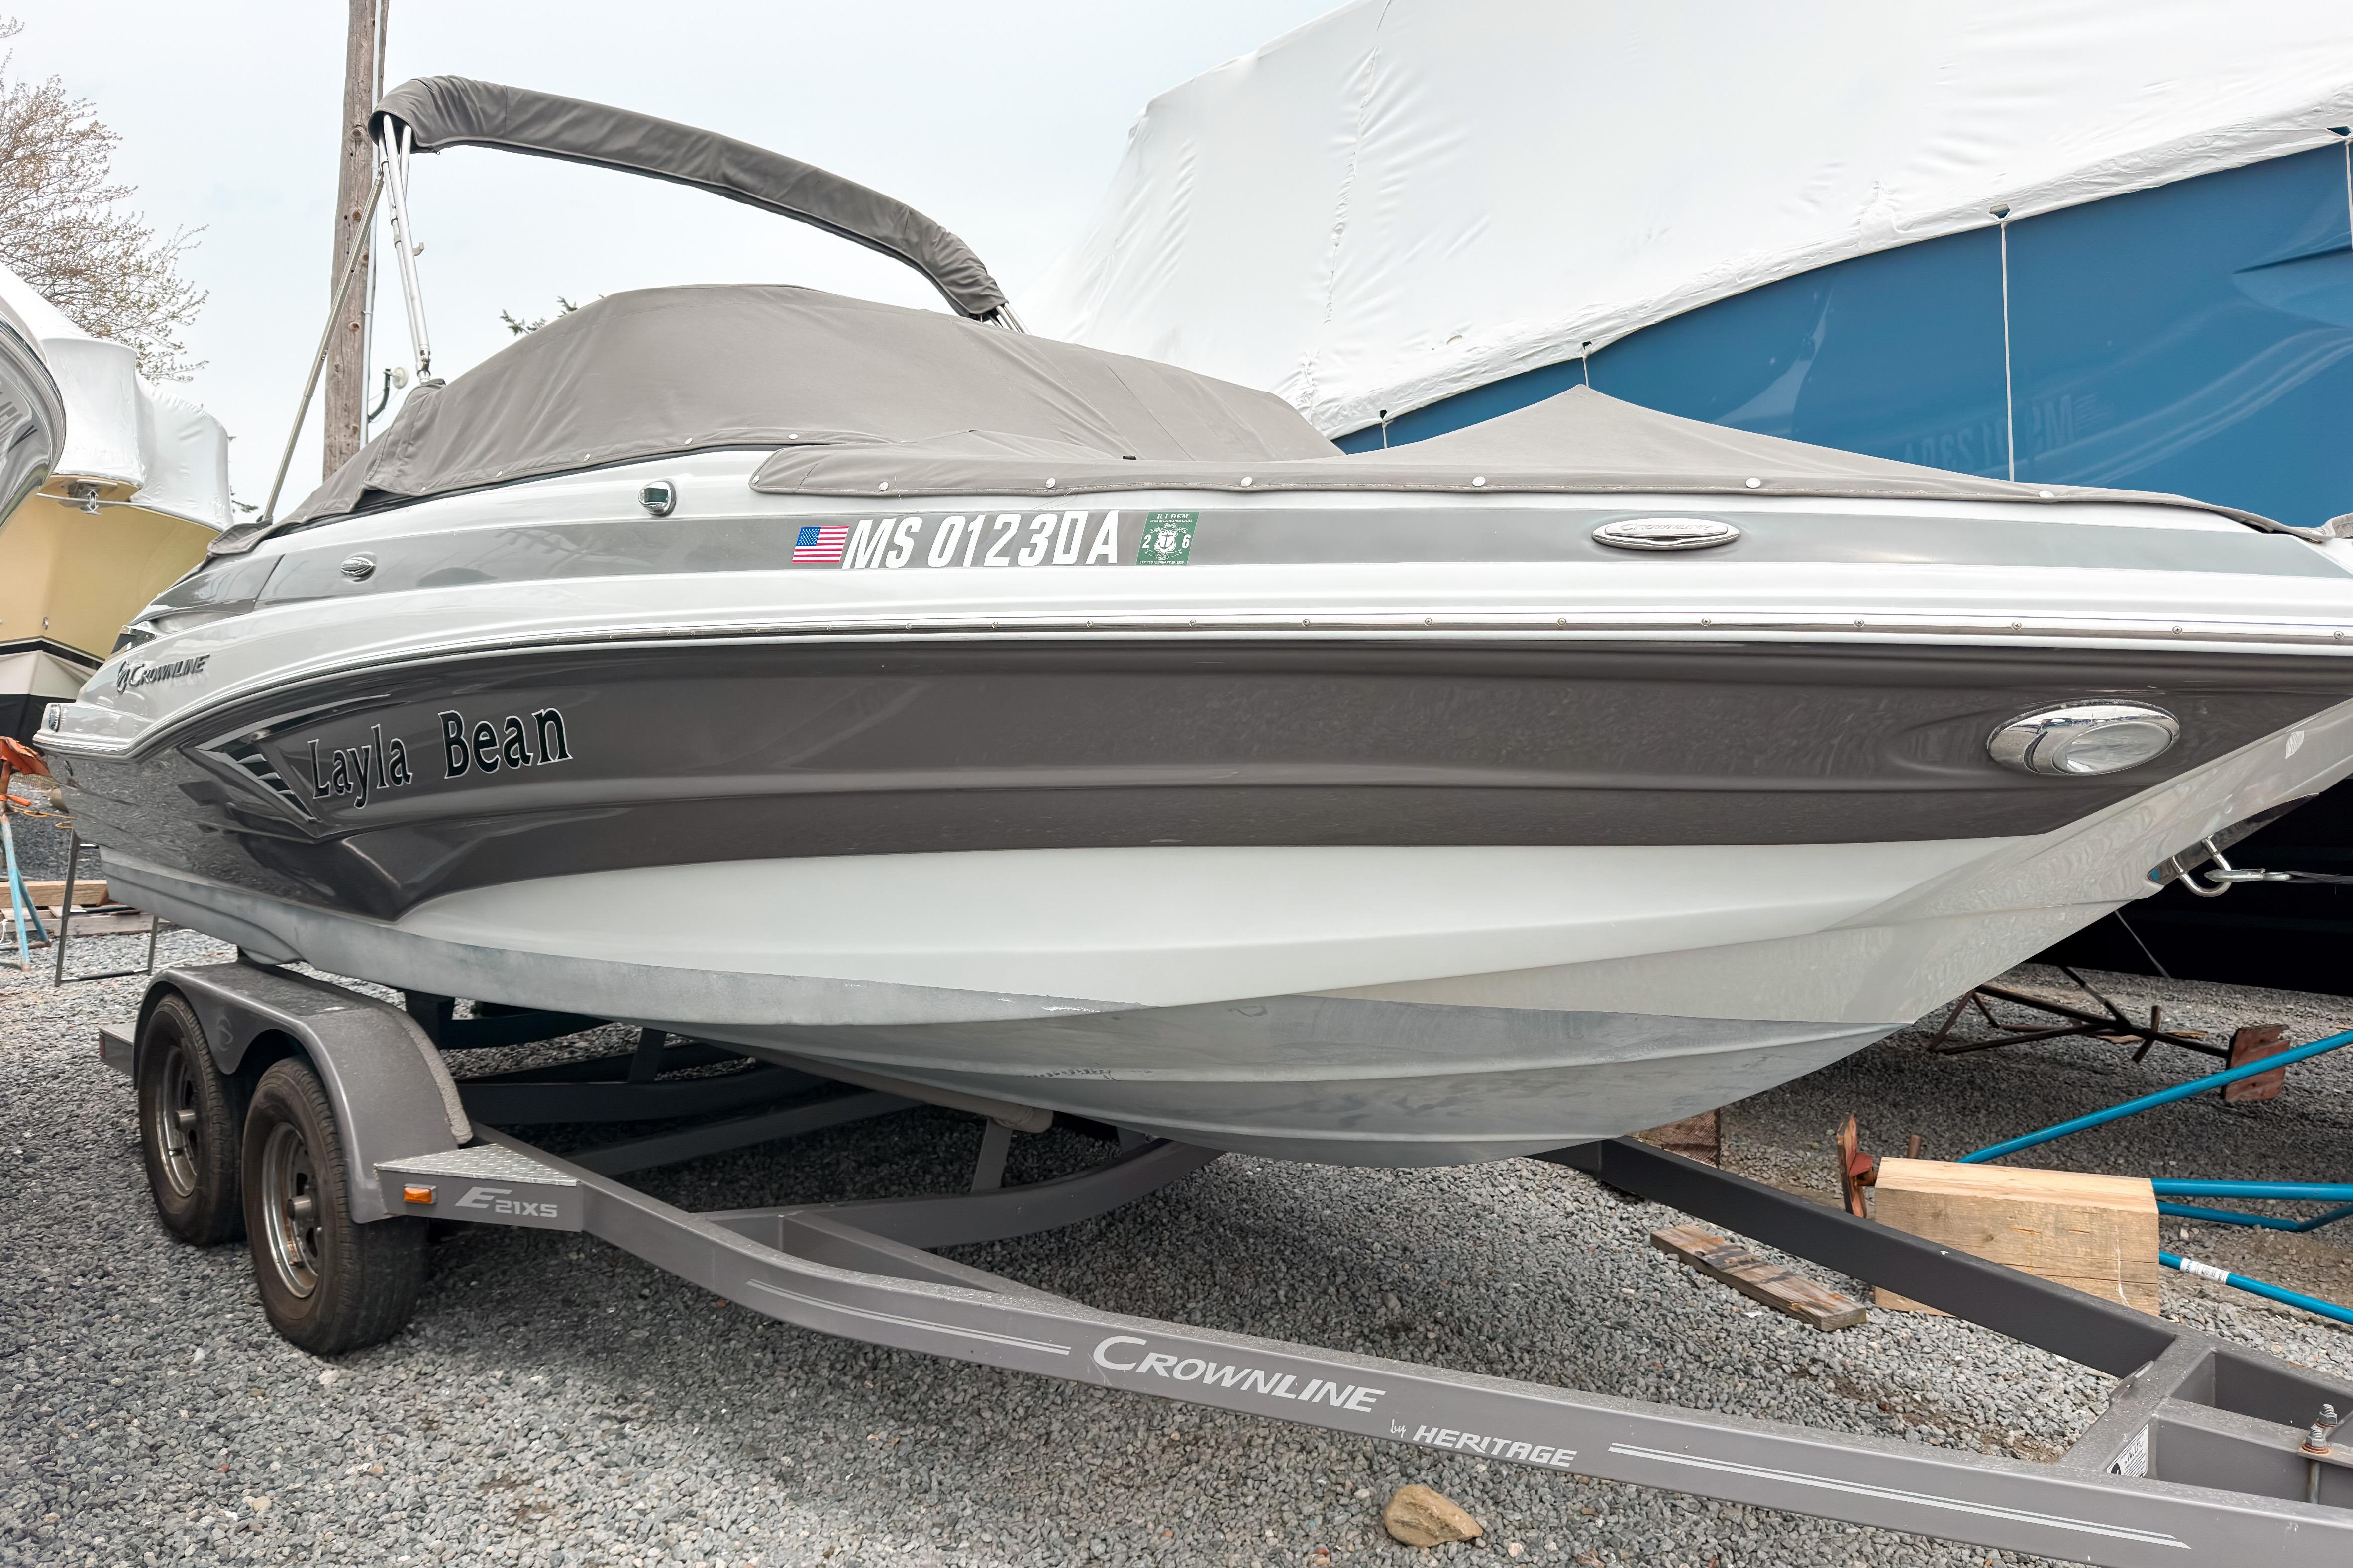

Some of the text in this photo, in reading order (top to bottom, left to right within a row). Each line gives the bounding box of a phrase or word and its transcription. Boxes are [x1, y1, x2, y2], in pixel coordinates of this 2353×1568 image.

[842, 510, 1119, 569] MS 0123DA
[1142, 534, 1191, 549] 2 6
[128, 654, 211, 687] CROWNLINE
[307, 707, 573, 809] Layla Bean
[1093, 1336, 1386, 1413] CROWNLINE
[1390, 1419, 1578, 1467] by HERITAGE
[2127, 1442, 2139, 1461] VAULT
